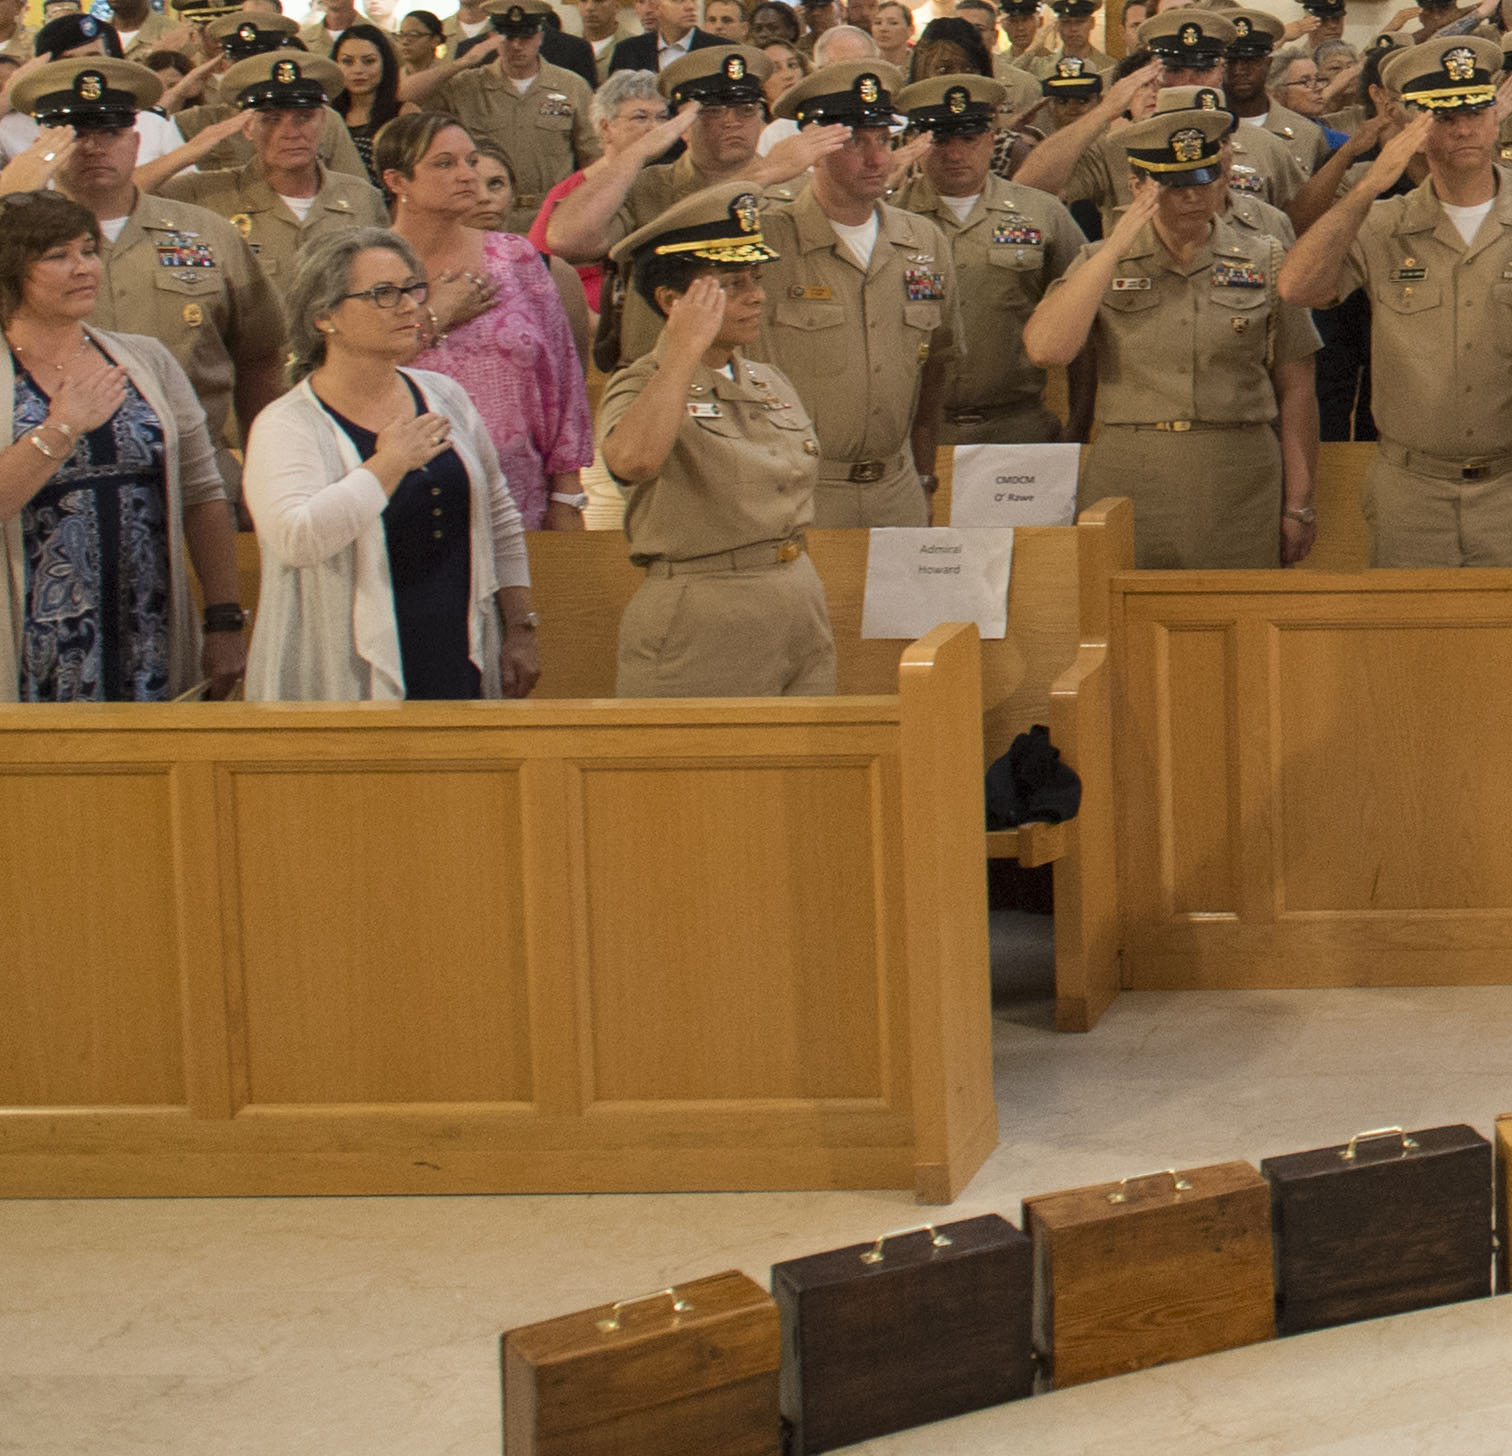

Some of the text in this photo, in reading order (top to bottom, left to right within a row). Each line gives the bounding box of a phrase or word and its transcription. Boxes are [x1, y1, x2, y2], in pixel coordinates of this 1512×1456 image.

[995, 475, 1035, 485] CMDCM
[919, 543, 962, 554] Admiral
[918, 564, 961, 575] Howard
